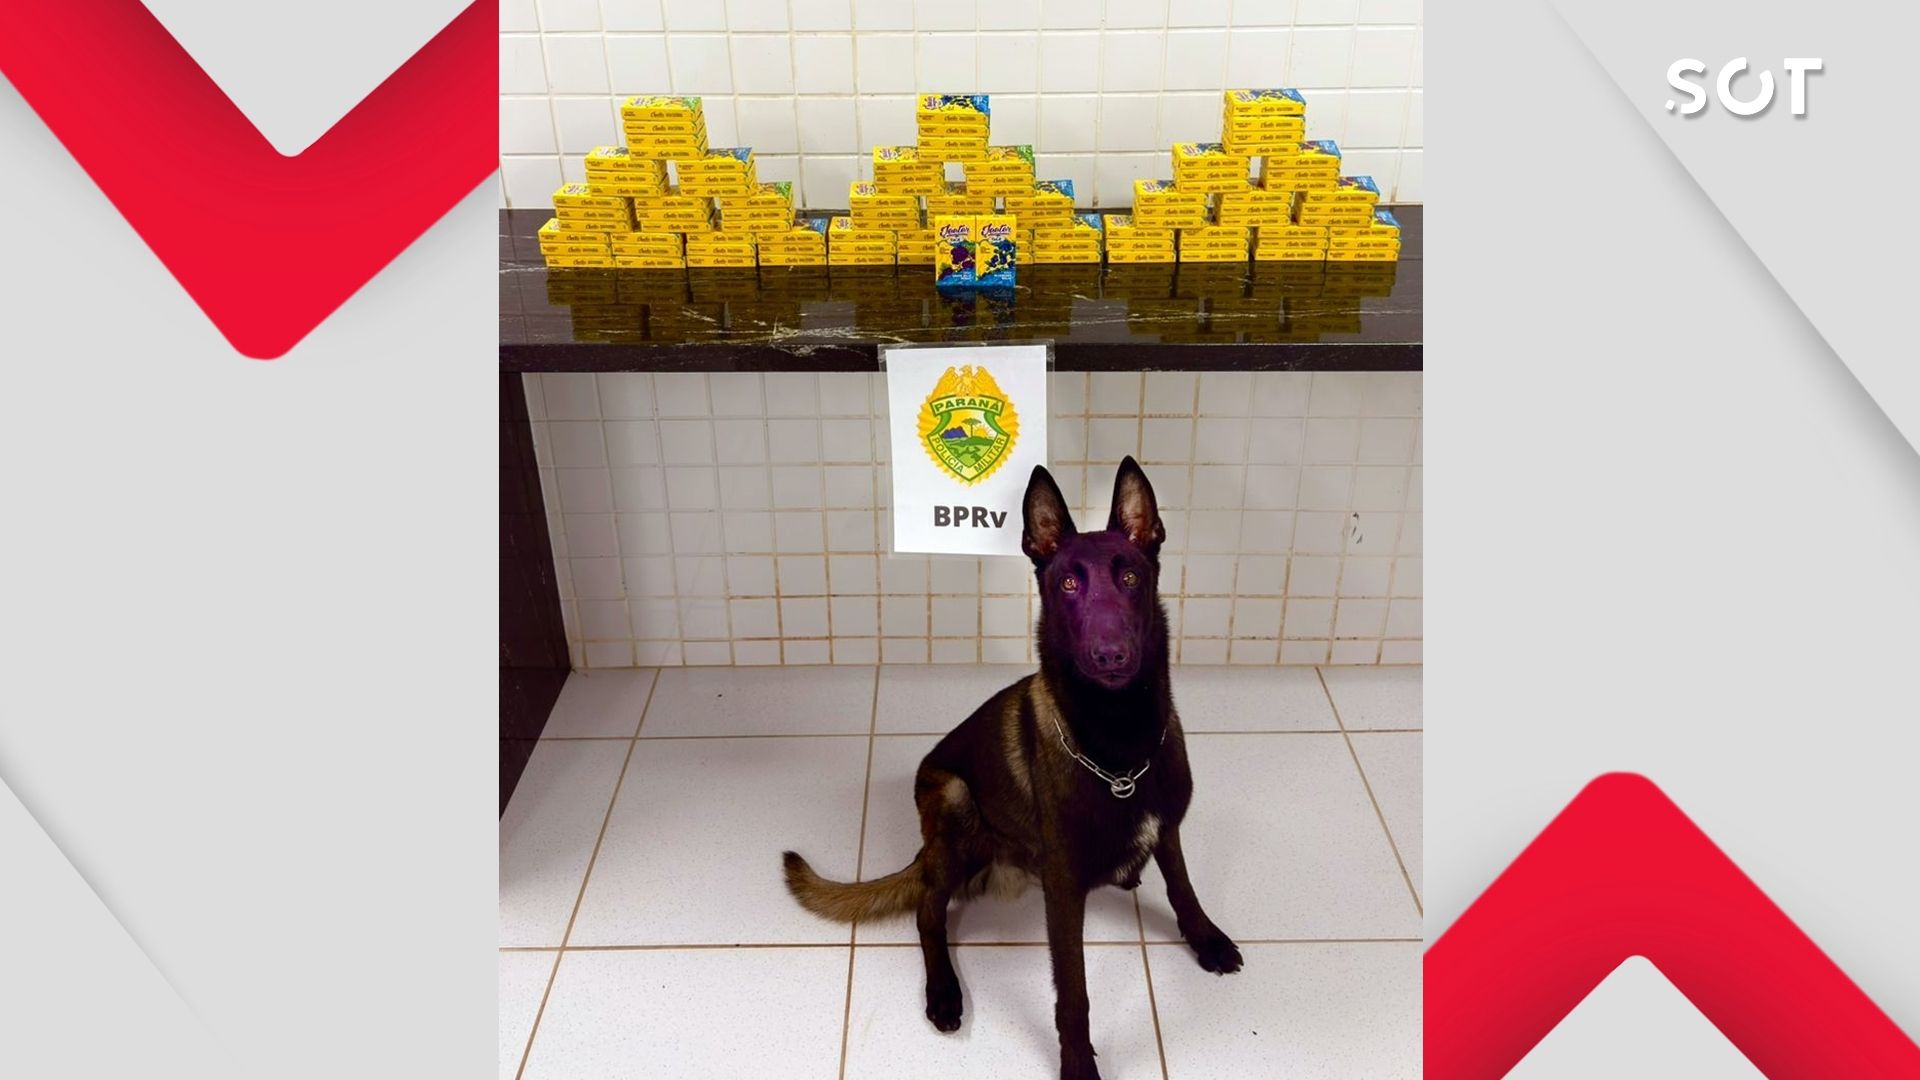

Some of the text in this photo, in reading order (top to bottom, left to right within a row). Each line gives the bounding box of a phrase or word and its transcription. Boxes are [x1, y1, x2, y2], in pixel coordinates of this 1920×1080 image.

[935, 398, 1000, 413] PARANÁ
[973, 437, 1005, 473] MILITAR
[934, 505, 1007, 528] BPRv
